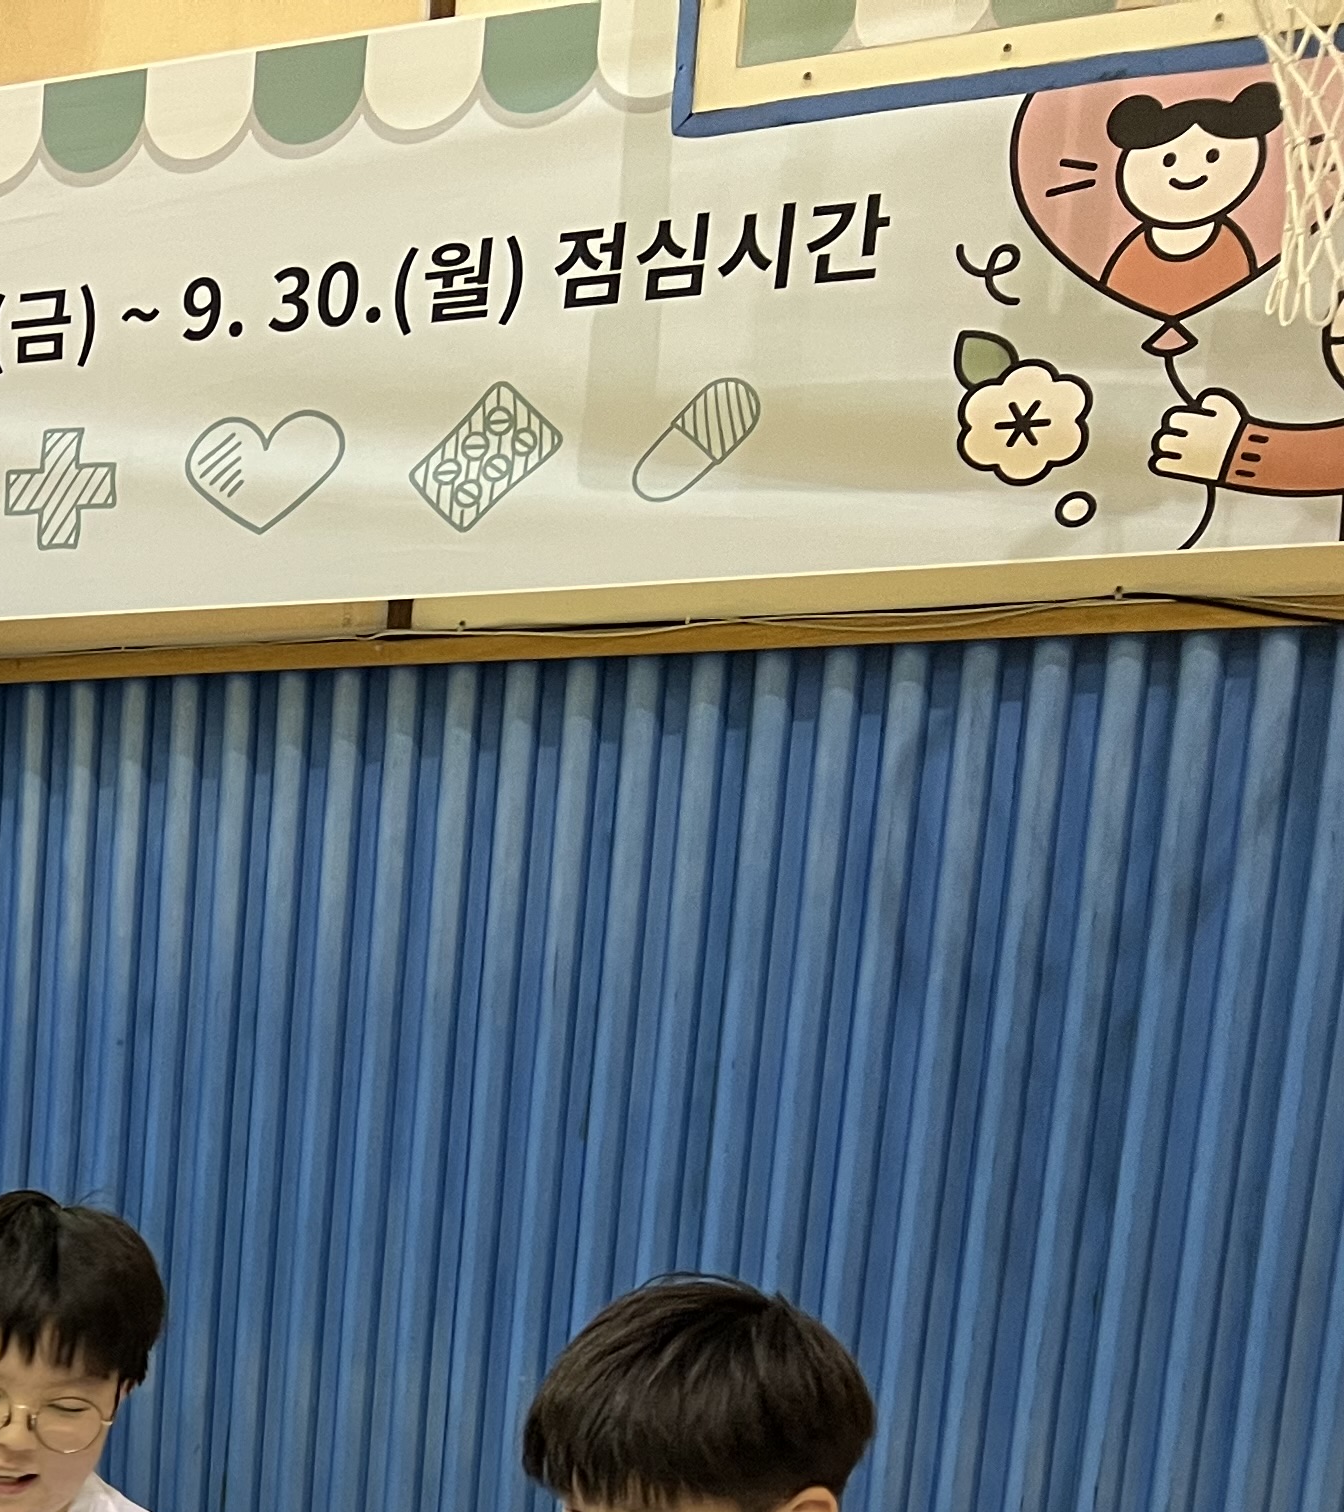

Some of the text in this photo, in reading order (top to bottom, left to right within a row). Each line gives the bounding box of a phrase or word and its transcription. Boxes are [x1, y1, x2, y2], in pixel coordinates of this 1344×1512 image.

[182, 276, 244, 342] 9.
[268, 235, 523, 336] 30.(월)
[554, 193, 890, 309] 점심시간
